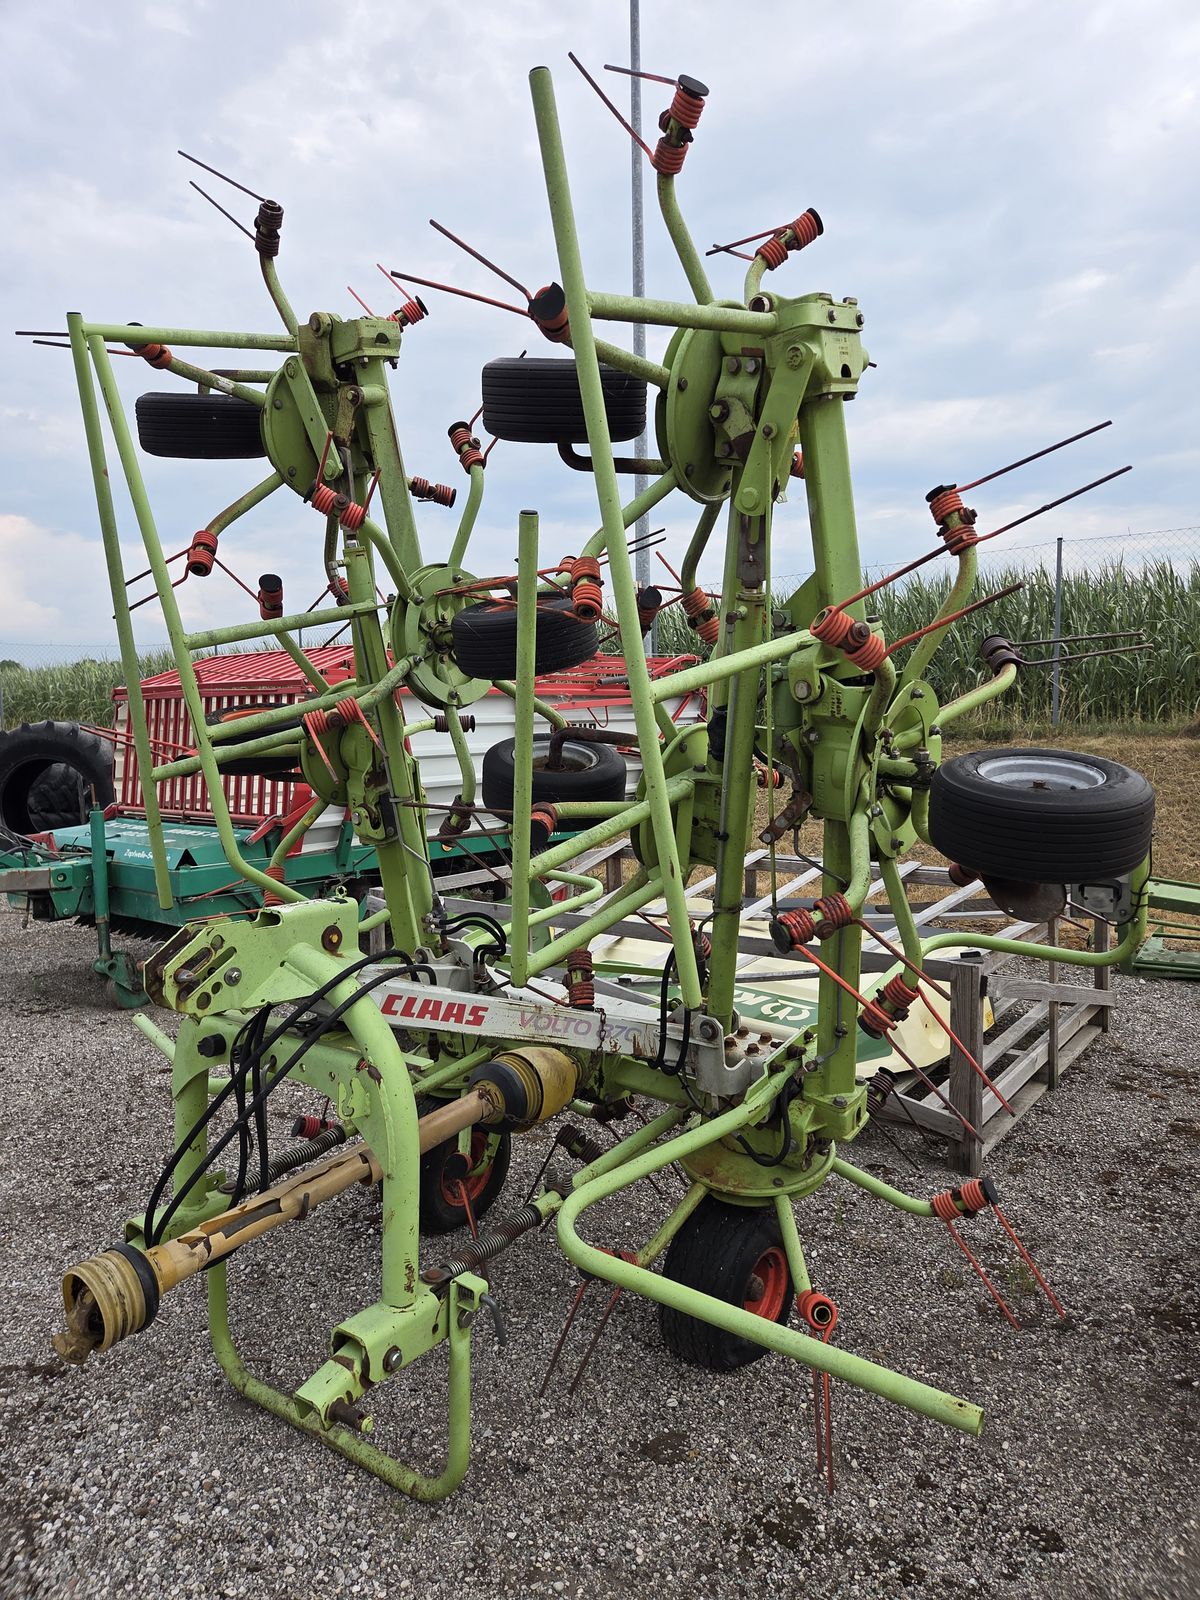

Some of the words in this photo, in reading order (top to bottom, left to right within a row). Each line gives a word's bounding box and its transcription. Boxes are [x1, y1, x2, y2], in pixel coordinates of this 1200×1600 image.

[380, 993, 489, 1027] CLAAS
[519, 1010, 592, 1036] VOLTO
[595, 1022, 643, 1041] 870
